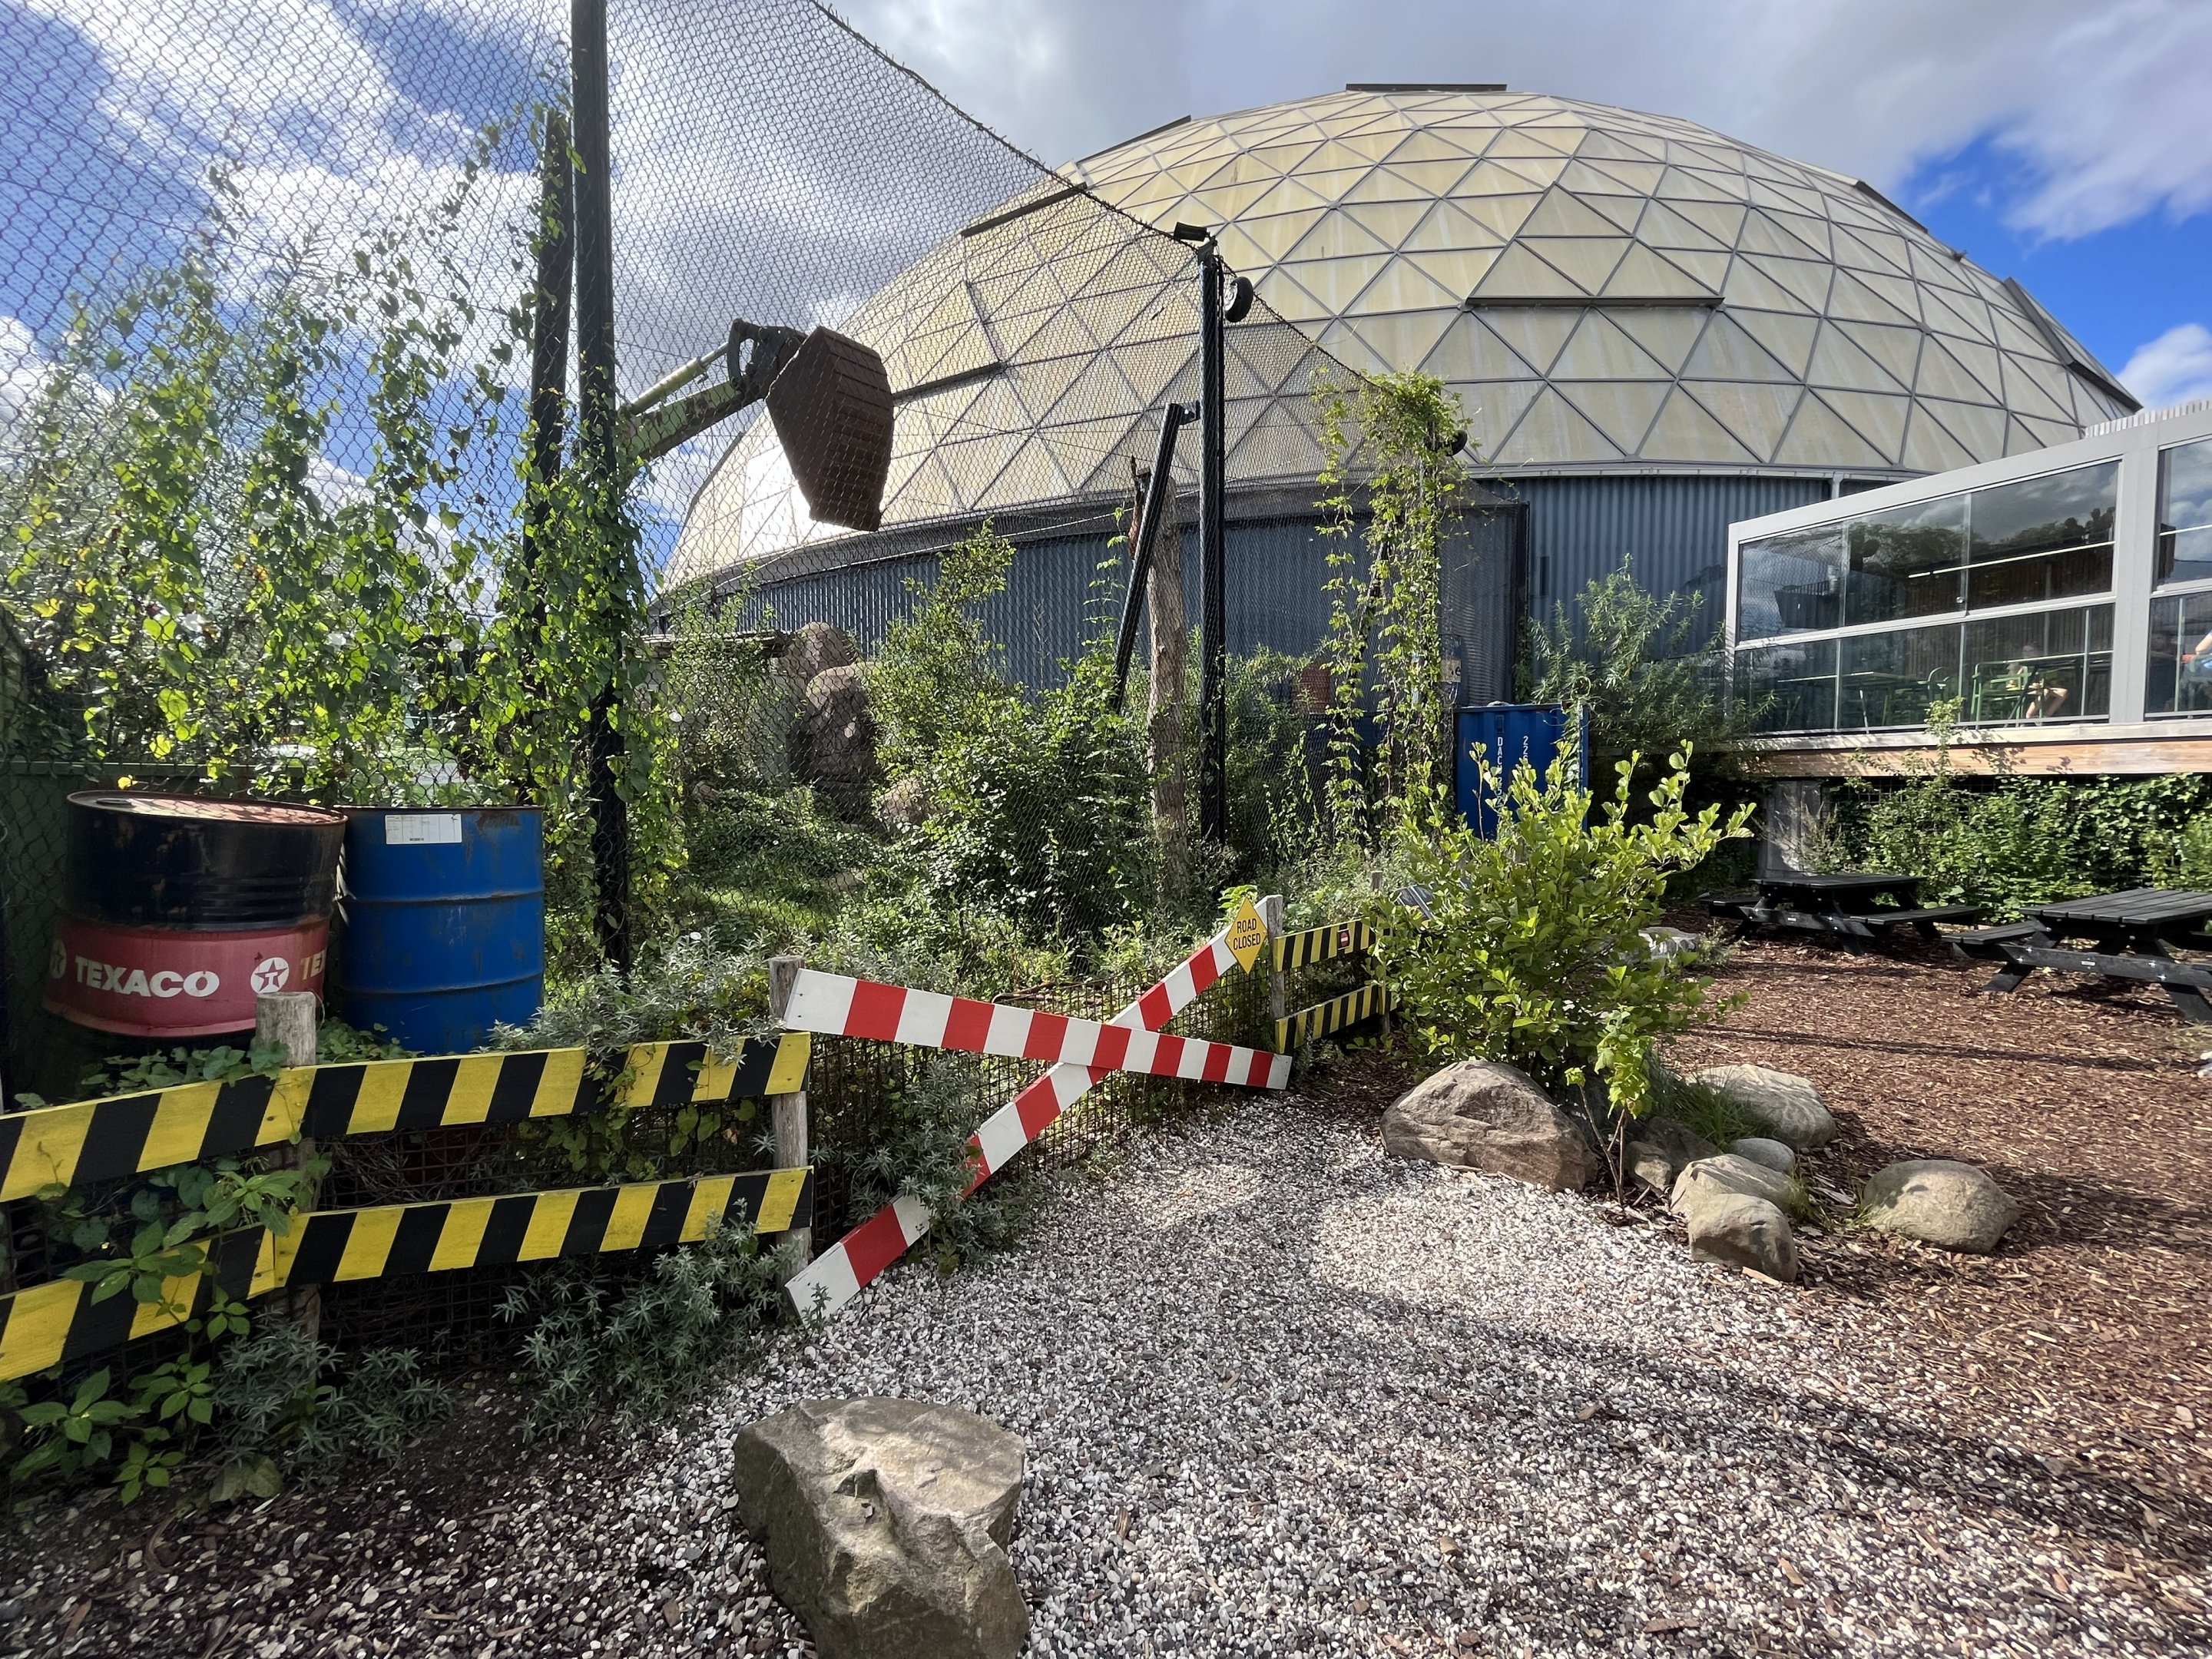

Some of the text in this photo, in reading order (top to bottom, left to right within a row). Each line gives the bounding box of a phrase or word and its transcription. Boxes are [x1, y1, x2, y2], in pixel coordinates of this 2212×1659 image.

[1237, 919, 1257, 934] ROAD
[1233, 932, 1261, 950] CLOSED
[75, 955, 220, 998] TEXACO
